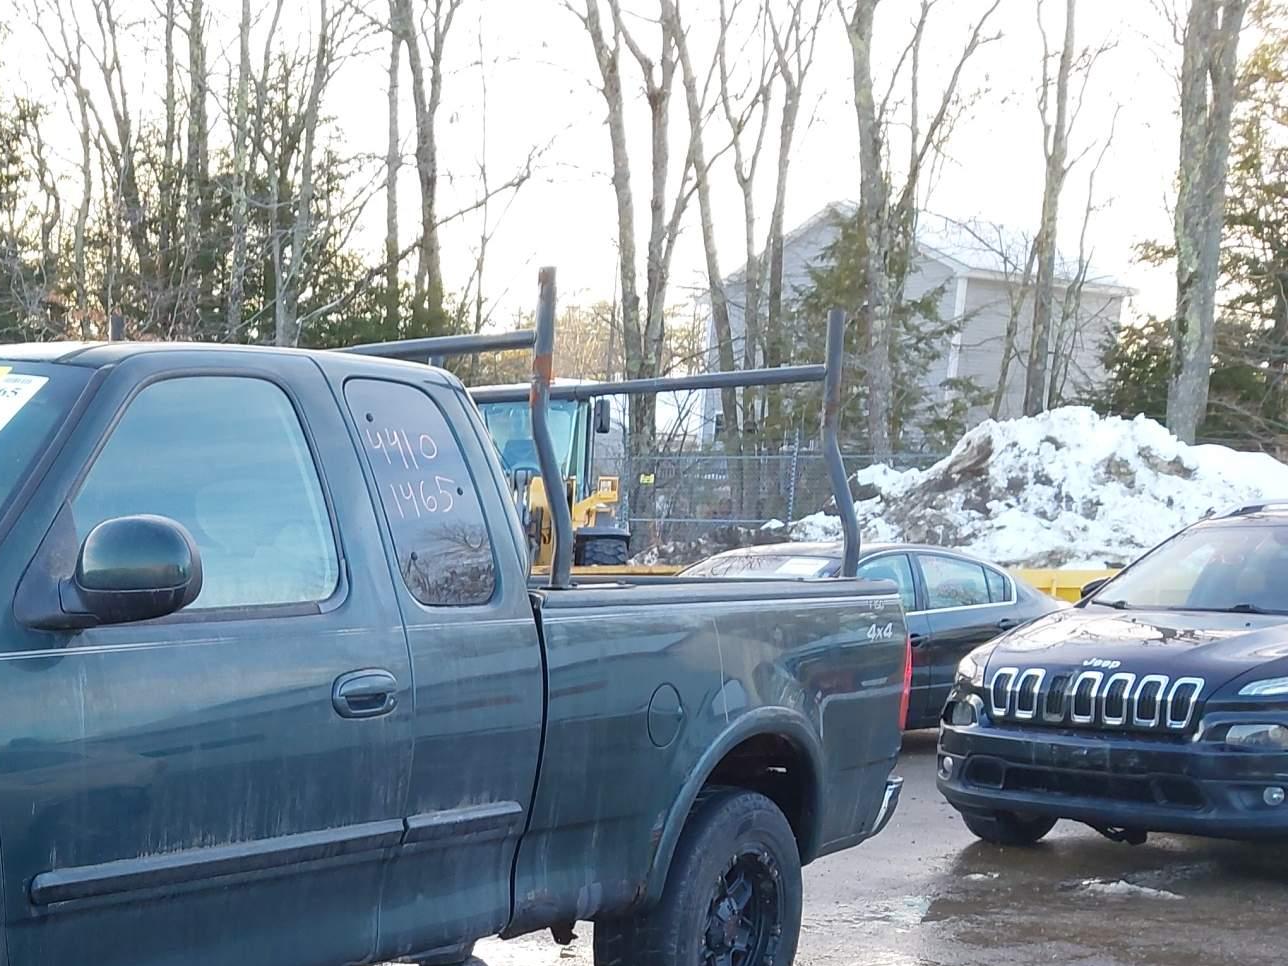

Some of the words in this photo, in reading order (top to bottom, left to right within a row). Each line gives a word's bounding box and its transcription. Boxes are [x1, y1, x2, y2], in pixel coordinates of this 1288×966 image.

[366, 428, 438, 469] 4410
[390, 476, 455, 518] 1465
[866, 622, 893, 640] 4x4
[1083, 658, 1121, 669] Jeep
